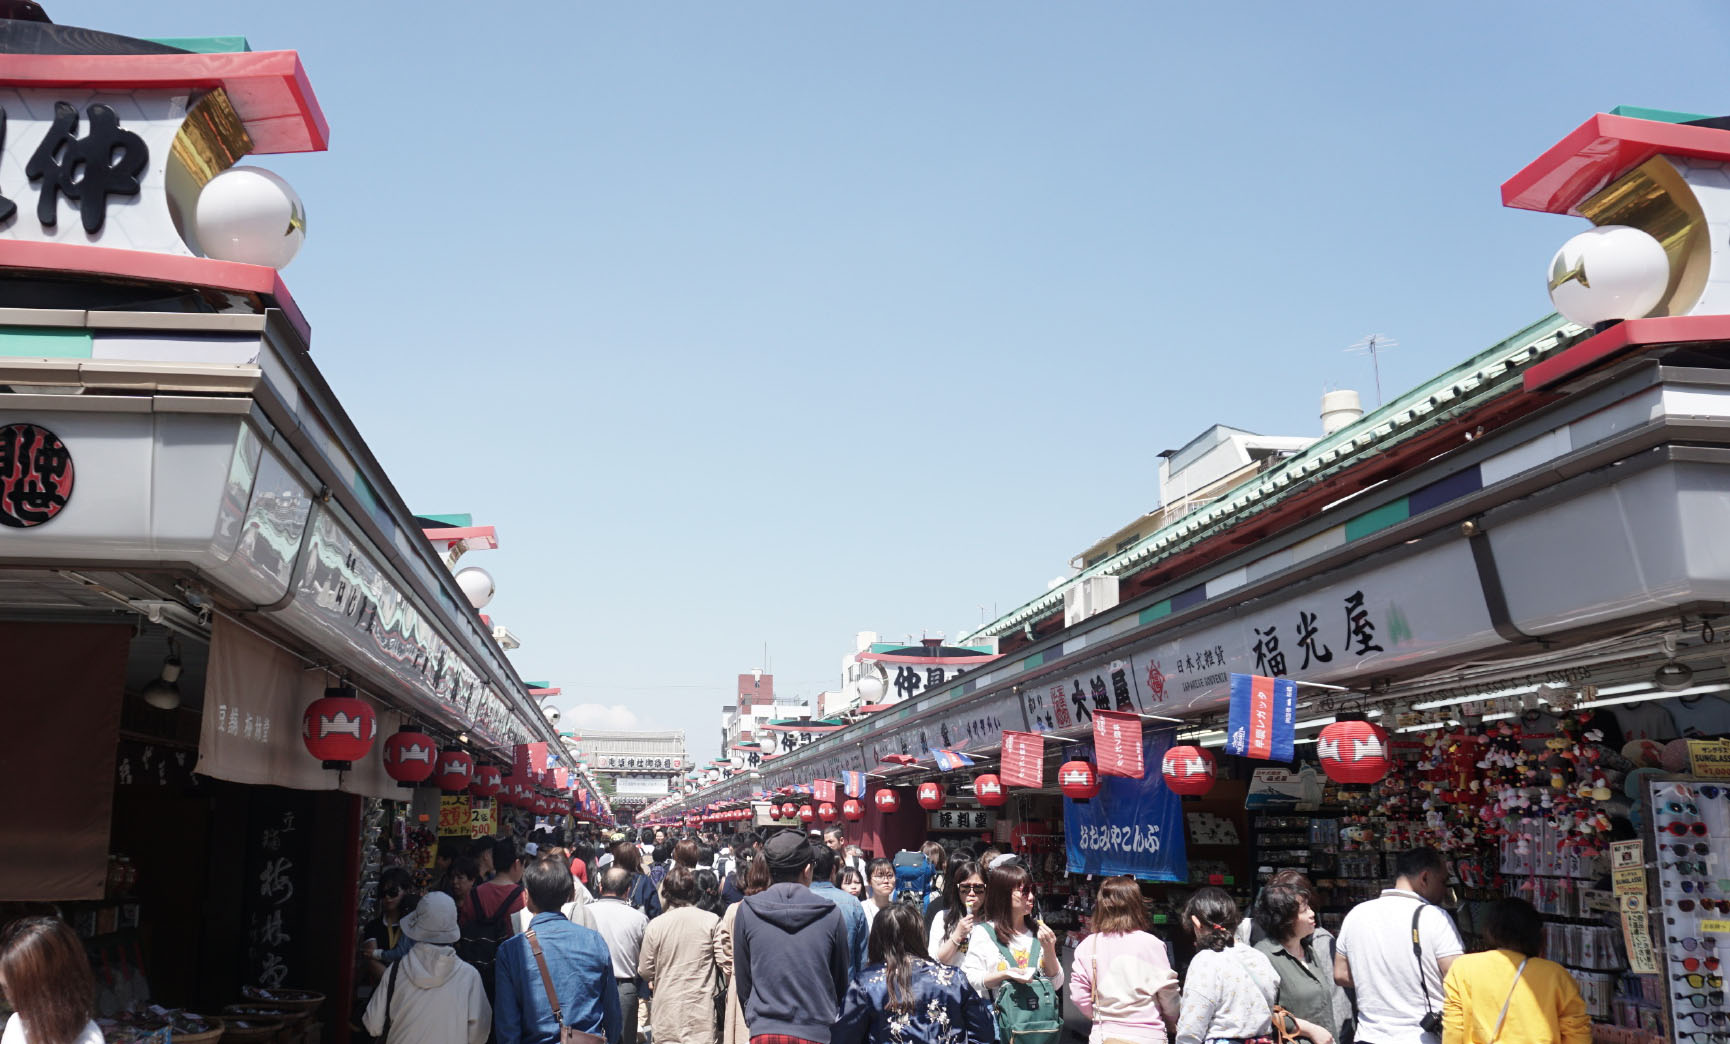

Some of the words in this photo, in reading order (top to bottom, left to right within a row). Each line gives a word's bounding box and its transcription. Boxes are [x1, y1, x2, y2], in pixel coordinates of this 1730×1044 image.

[0, 101, 149, 235] 仲
[1252, 590, 1384, 677] 福光屋
[1255, 691, 1268, 749] 早慶レガッタ
[471, 823, 490, 838] 500
[939, 812, 988, 828] 評判堂
[1080, 824, 1160, 854] おおみやこんぶ
